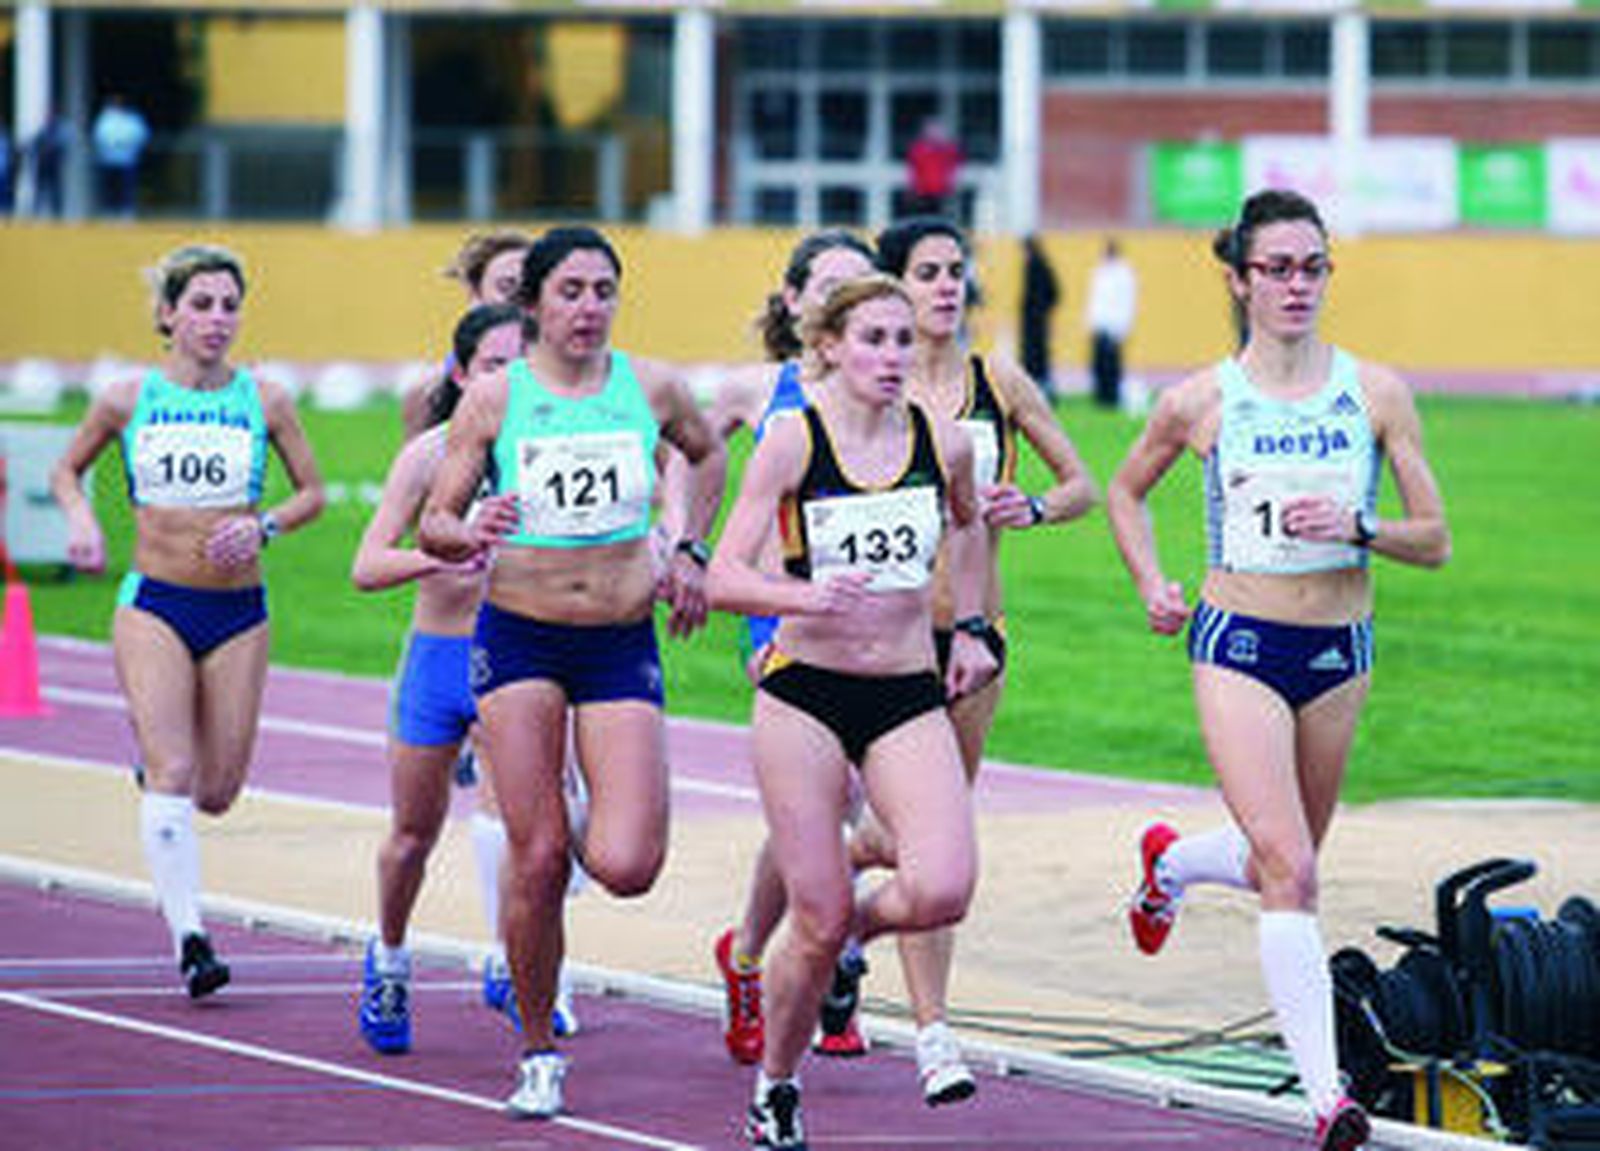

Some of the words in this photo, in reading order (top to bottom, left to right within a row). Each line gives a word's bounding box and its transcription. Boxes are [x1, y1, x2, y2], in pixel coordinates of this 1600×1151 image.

[1254, 426, 1349, 459] nerja
[158, 453, 226, 486] 106
[545, 465, 618, 508] 121
[839, 524, 918, 564] 133
